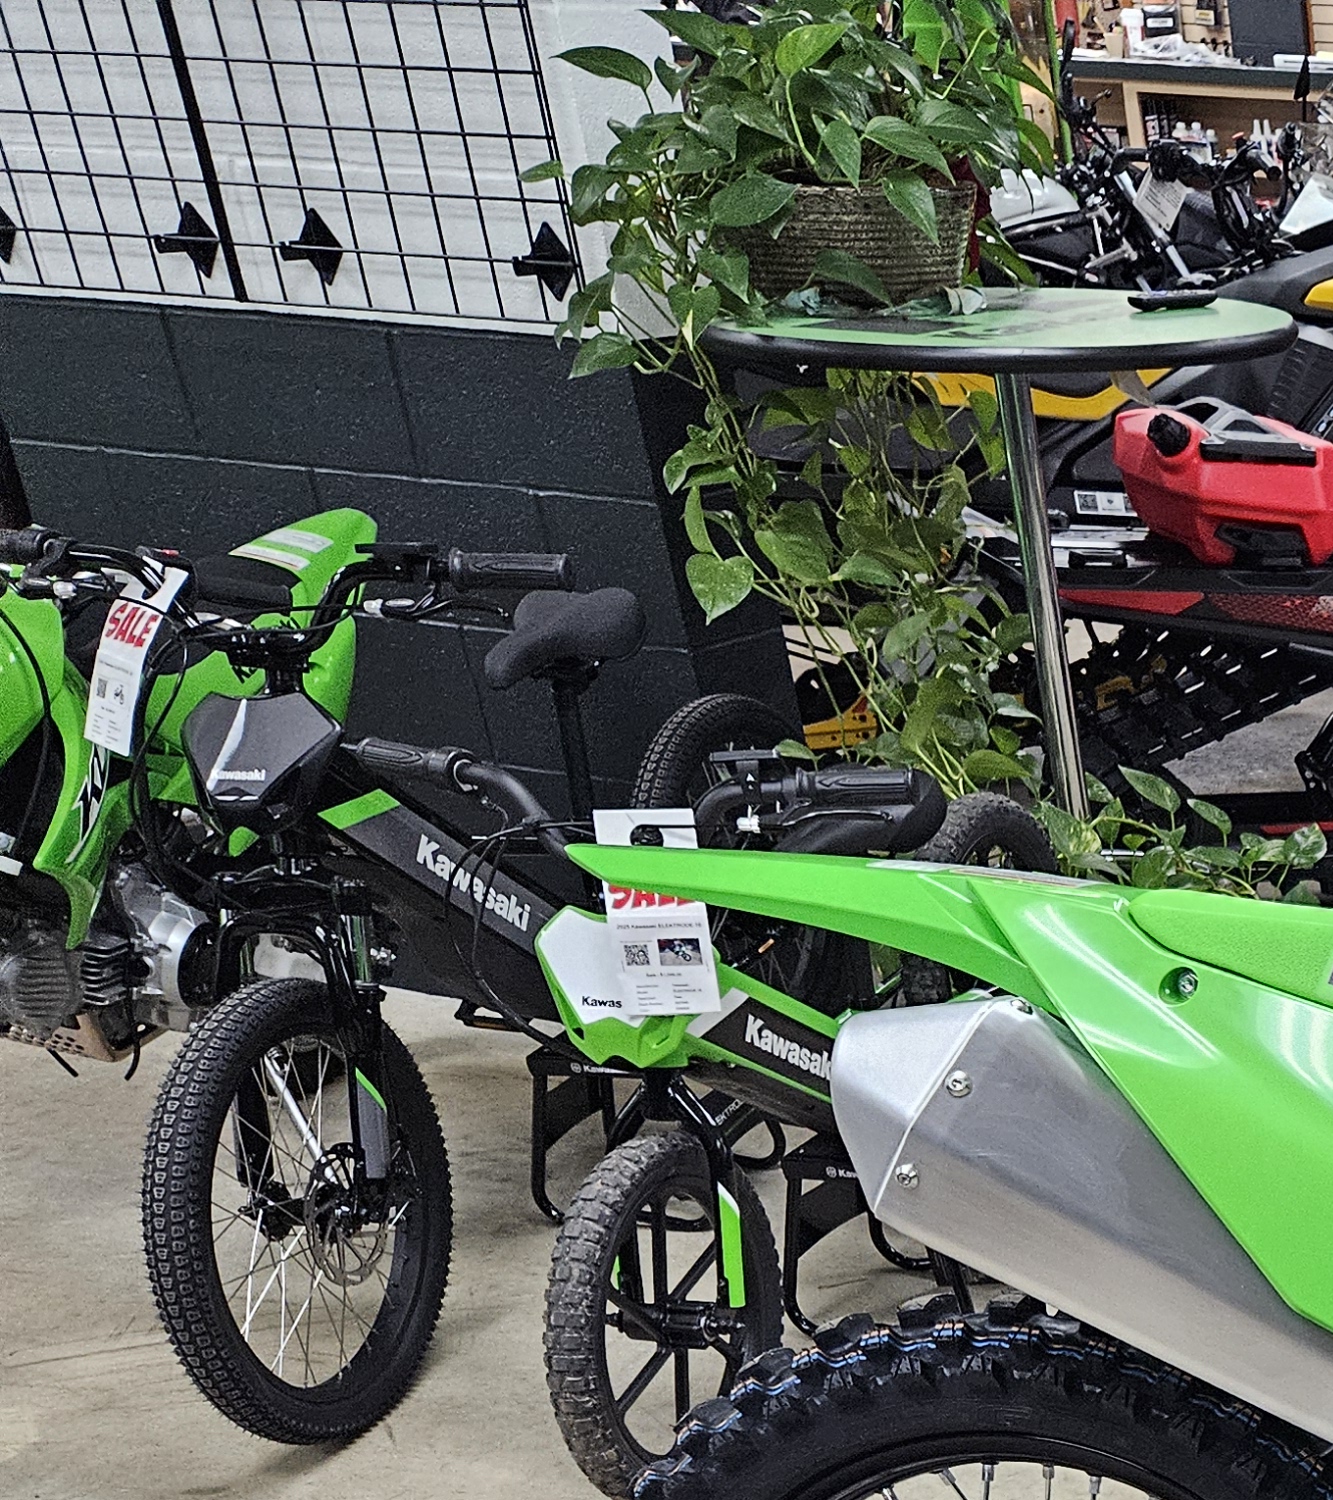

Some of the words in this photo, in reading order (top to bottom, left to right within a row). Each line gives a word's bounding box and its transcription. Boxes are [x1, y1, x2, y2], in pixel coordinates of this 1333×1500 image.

[105, 602, 159, 647] SALE
[210, 768, 266, 783] Kawasaki
[416, 834, 531, 932] Kawasaki
[582, 995, 622, 1008] Kawas
[745, 1013, 832, 1081] Kawasak
